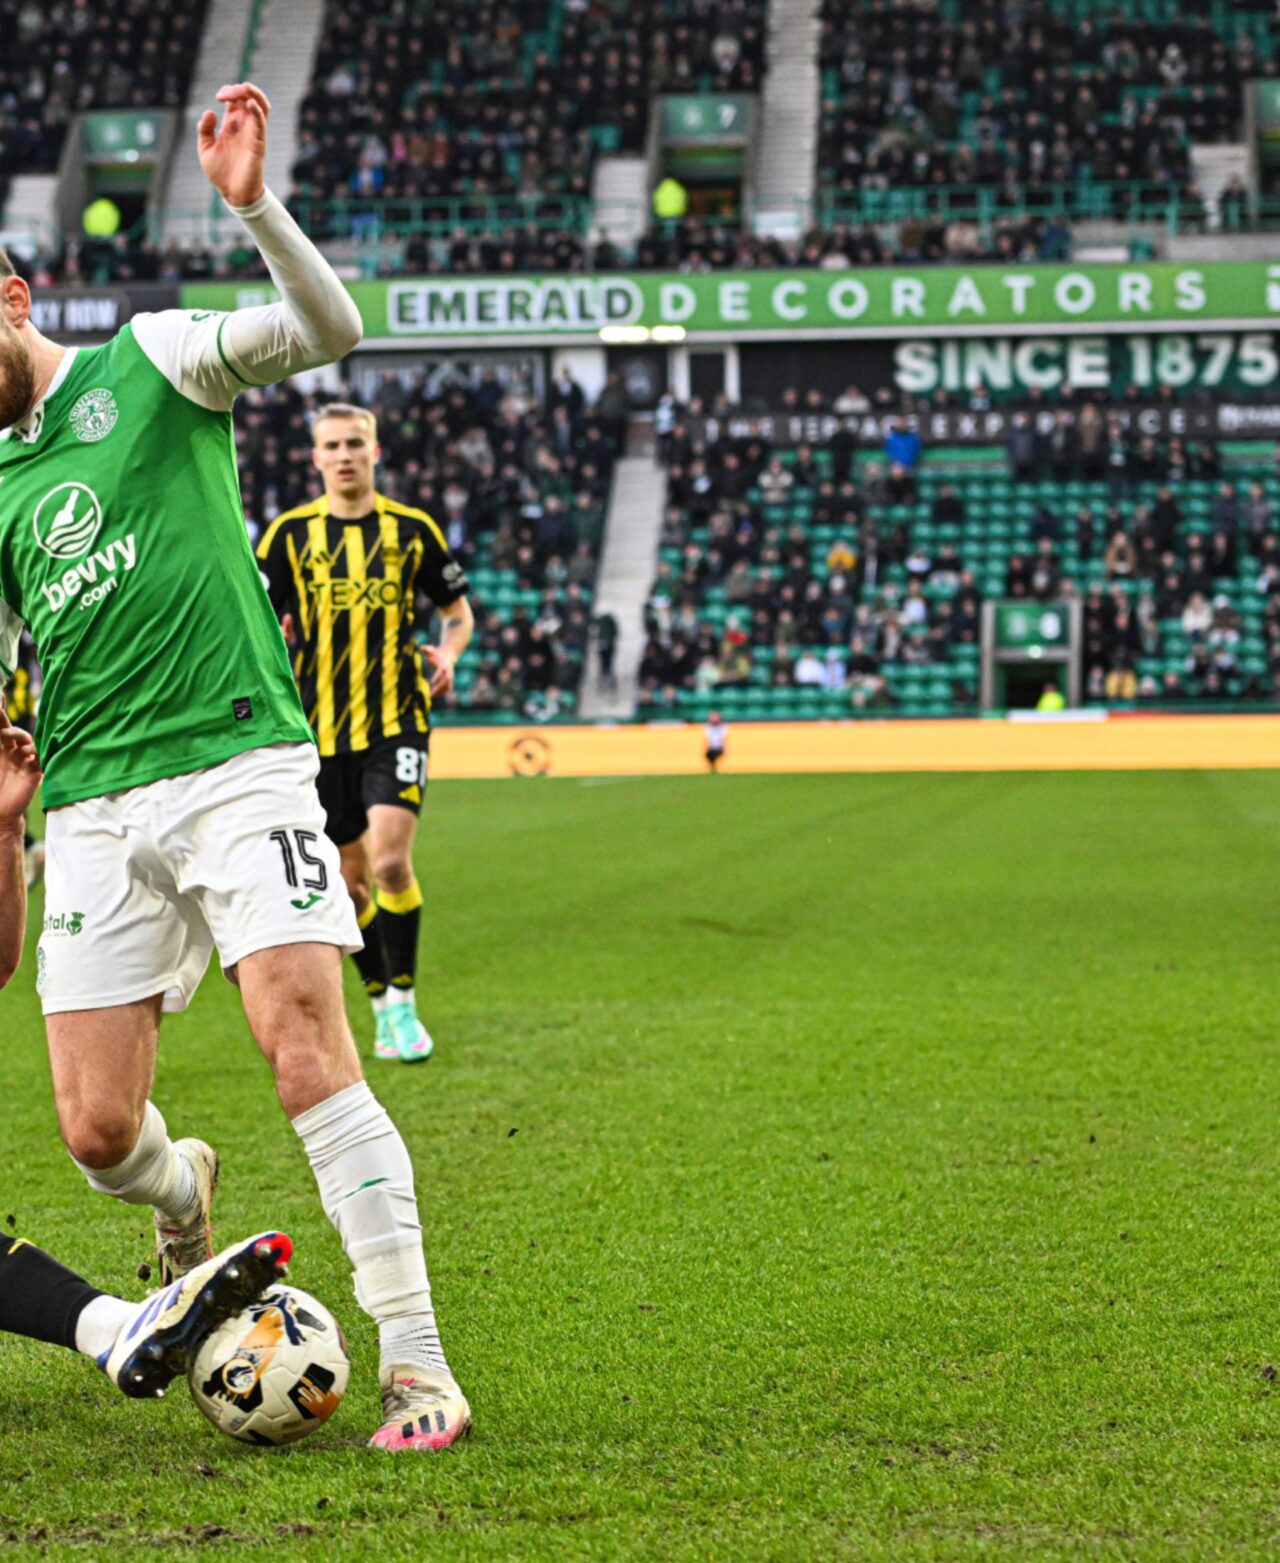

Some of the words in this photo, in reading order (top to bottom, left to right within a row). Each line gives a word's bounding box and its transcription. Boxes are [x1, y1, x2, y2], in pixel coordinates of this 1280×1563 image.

[389, 278, 644, 332] EMERALD
[660, 270, 1206, 321] DECORATORS
[893, 338, 1110, 392] SINCE
[1128, 333, 1280, 387] 1875
[42, 533, 137, 612] bevvy
[79, 576, 118, 610] .com
[309, 579, 402, 608] TEXO
[270, 829, 327, 891] 15
